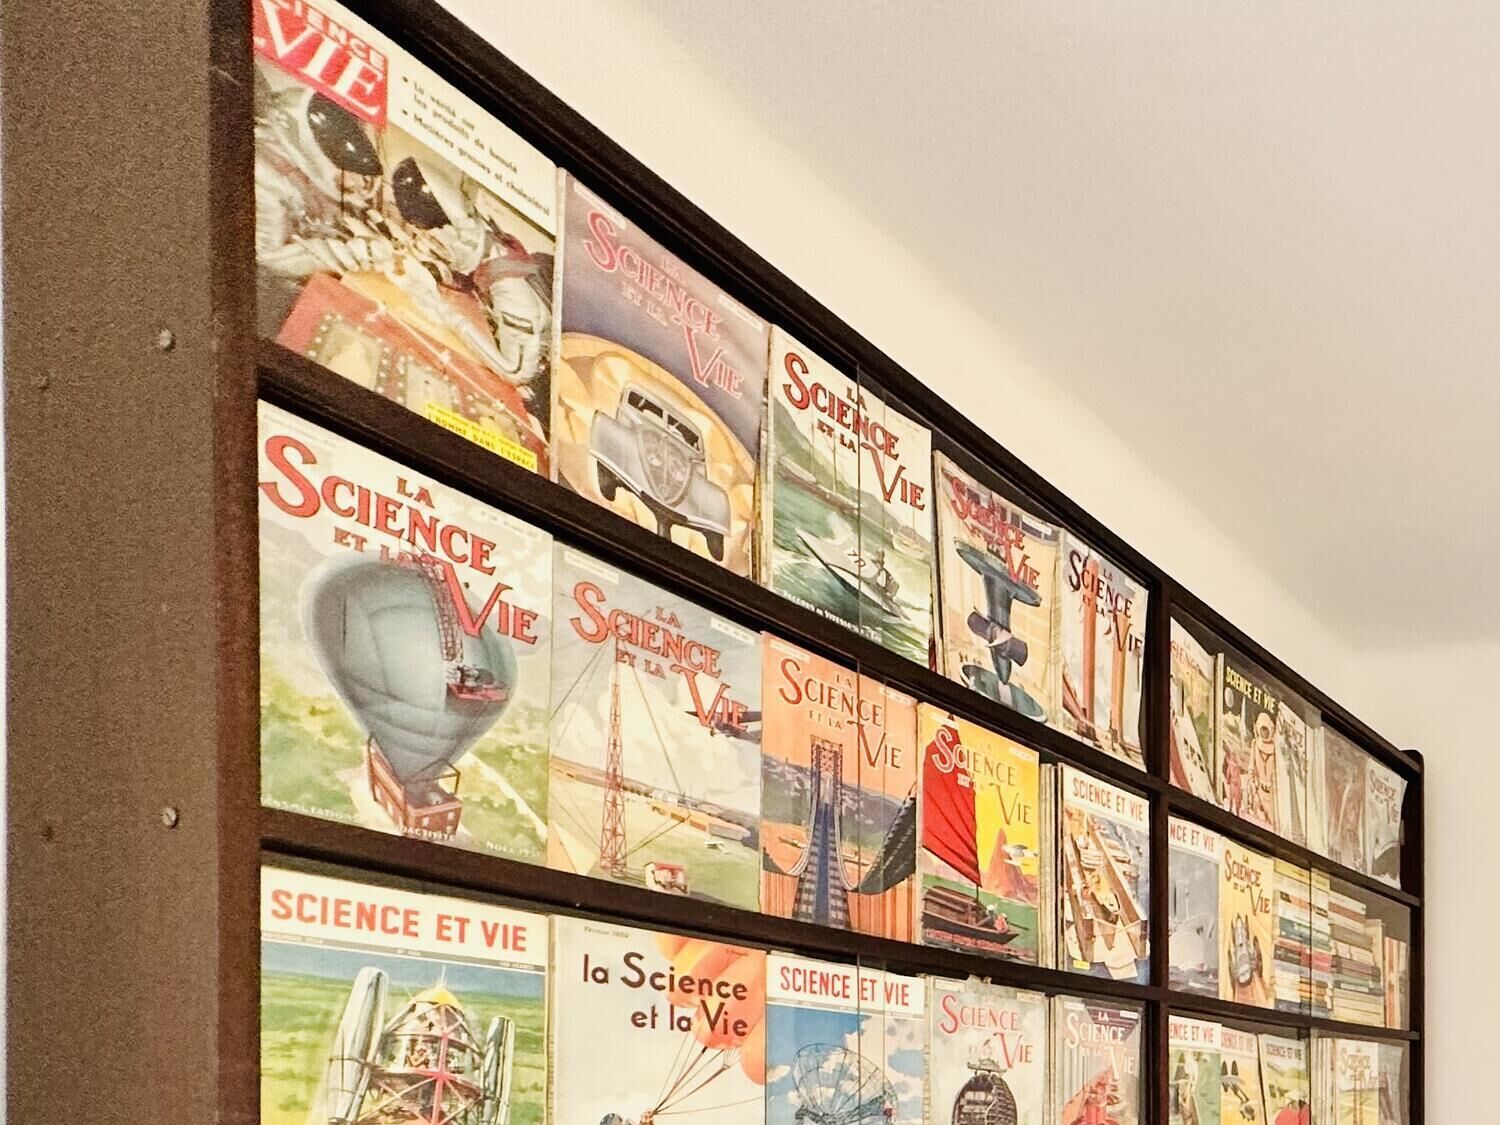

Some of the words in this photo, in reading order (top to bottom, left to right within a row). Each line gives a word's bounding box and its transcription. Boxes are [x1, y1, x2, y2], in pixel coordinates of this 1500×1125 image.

[583, 209, 723, 342] SCIENCE
[671, 314, 745, 400] VIE
[782, 351, 900, 461] SCIENCE
[845, 385, 868, 412] LA
[396, 476, 436, 509] LA
[839, 432, 858, 454] LA
[860, 441, 926, 512] VIE
[259, 435, 497, 577] SCIENCE
[332, 525, 369, 553] ET
[416, 552, 540, 646] VIE
[569, 581, 723, 679] SCIENCE
[655, 605, 683, 630] LA
[669, 663, 749, 732] VIE
[778, 658, 884, 728] SCIENCE
[835, 672, 854, 690] LA
[1226, 665, 1252, 700] SCIENCE
[846, 719, 903, 770] VIE
[931, 727, 1016, 788] SCIENCE
[988, 782, 1032, 826] VIE
[1072, 776, 1112, 809] SCIENCE
[1116, 794, 1126, 815] ET
[1130, 799, 1144, 822] VIE
[1191, 829, 1201, 847] ET
[1203, 833, 1215, 854] VIE
[1223, 849, 1262, 888] SCIENCE
[271, 888, 419, 938] SCIENCE
[435, 913, 471, 944] ET
[480, 919, 528, 953] VIE
[1245, 883, 1271, 917] VIE
[583, 953, 610, 985] la
[620, 951, 748, 1001] Science
[780, 966, 851, 1000] SCIENCE
[860, 977, 878, 1002] ET
[883, 981, 910, 1007] VIE
[630, 1004, 659, 1030] et
[669, 1003, 693, 1033] la
[700, 999, 749, 1037] Vie
[939, 994, 1019, 1034] SCIENCE
[1065, 1012, 1126, 1049] SCIENCE
[1097, 1010, 1110, 1023] LA
[1191, 1025, 1201, 1042] ET
[992, 1031, 1033, 1069] VIE
